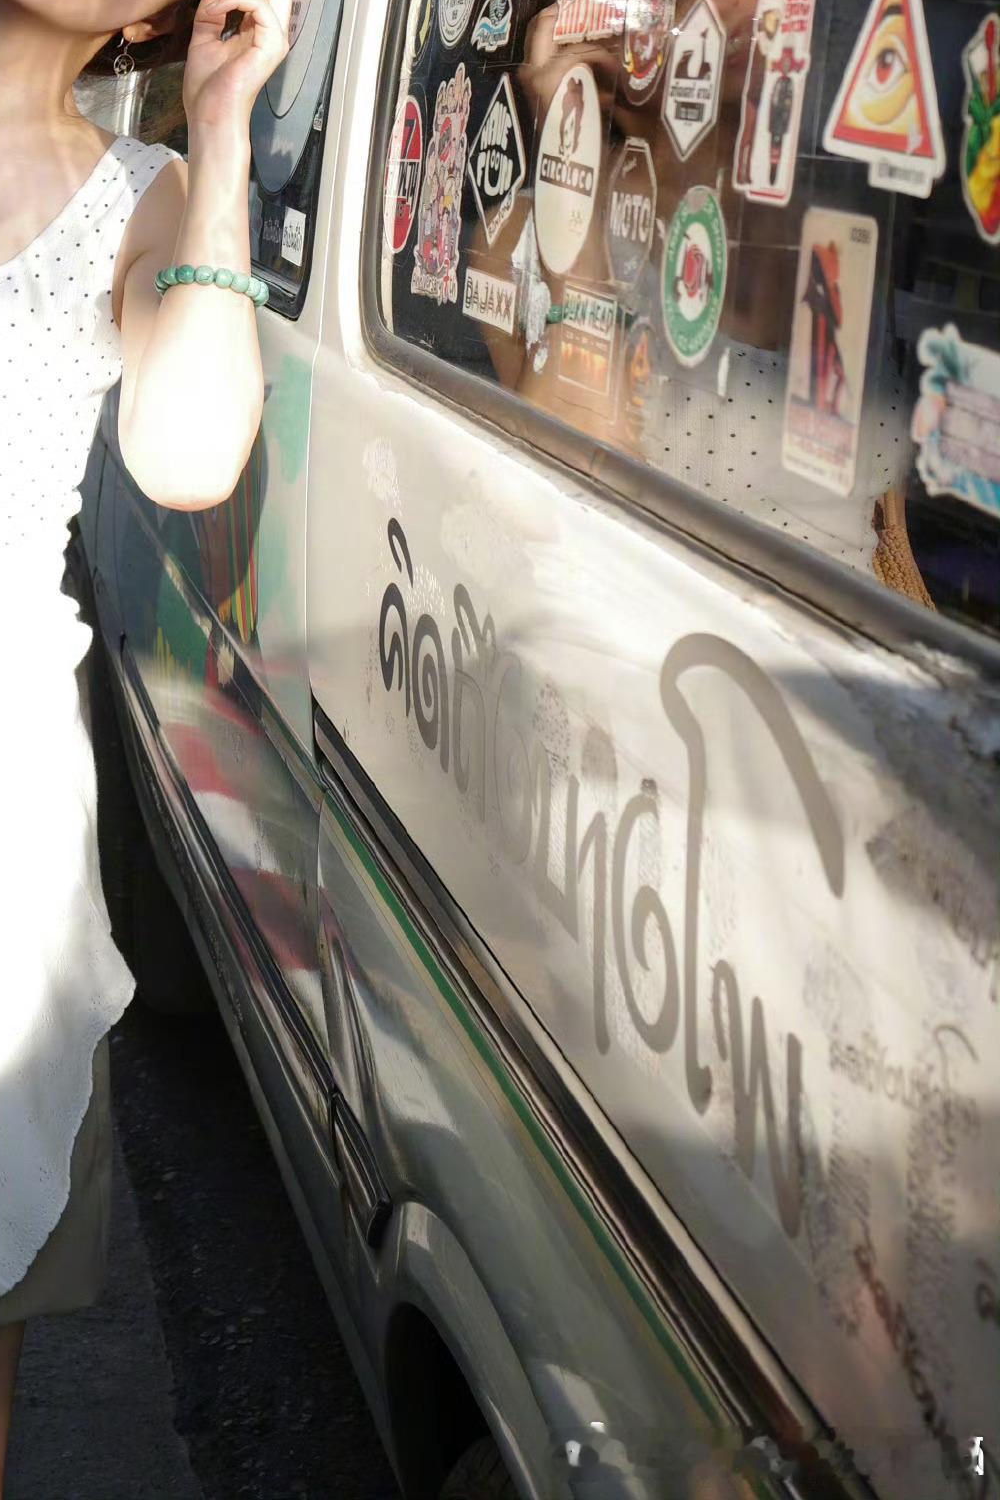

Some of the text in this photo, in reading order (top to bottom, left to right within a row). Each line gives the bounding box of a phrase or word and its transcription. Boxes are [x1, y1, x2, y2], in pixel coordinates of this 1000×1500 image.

[480, 100, 513, 150] HAVE
[541, 156, 593, 192] CIRCOLOCO
[609, 190, 650, 243] MOTO
